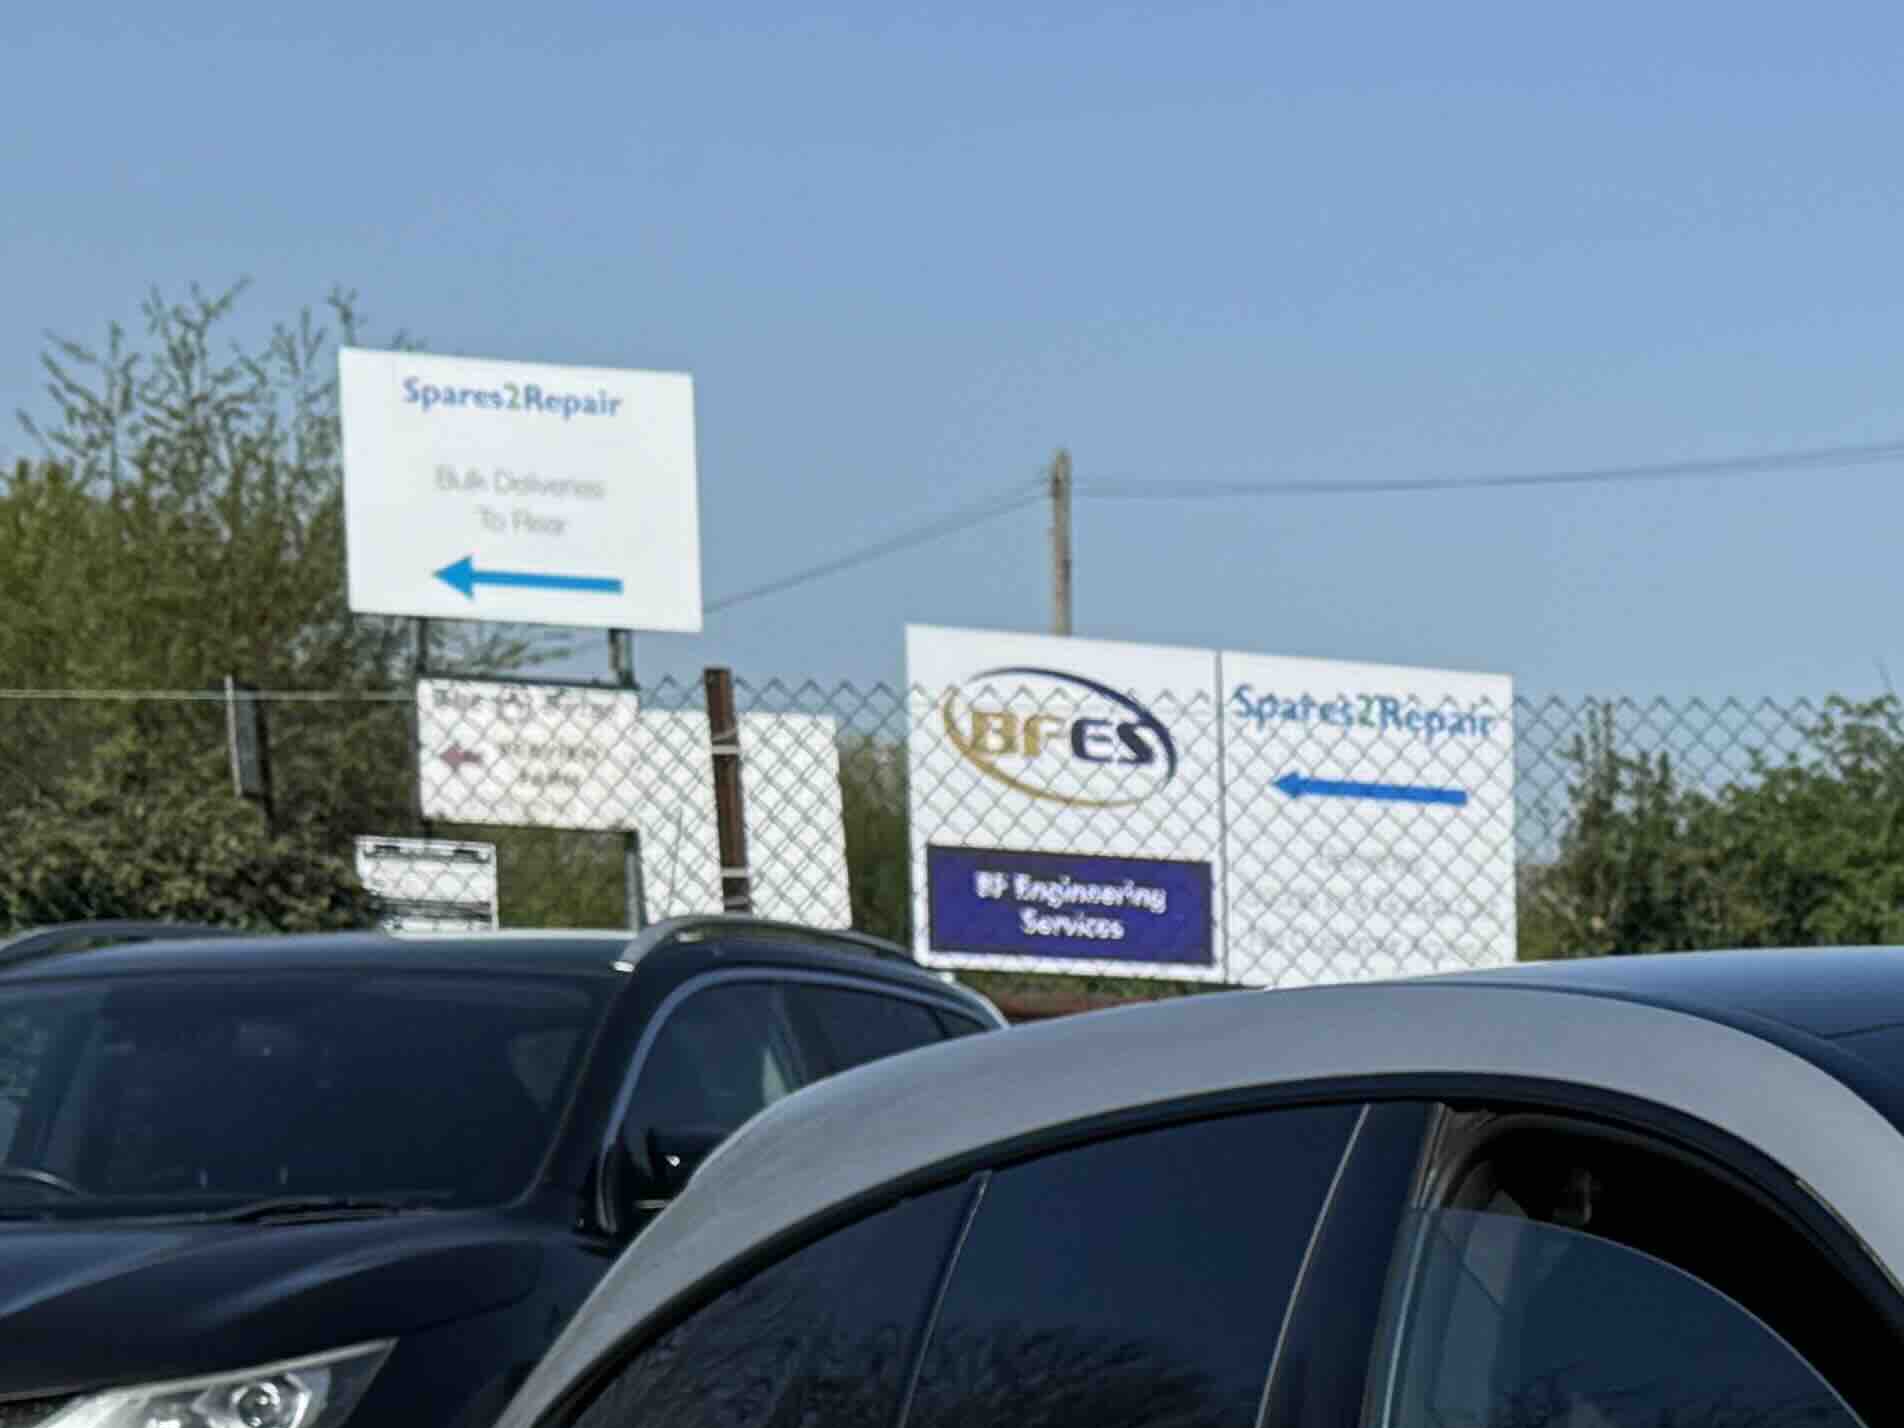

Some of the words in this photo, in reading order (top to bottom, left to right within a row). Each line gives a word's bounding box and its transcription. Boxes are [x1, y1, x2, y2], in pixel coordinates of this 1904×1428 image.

[403, 376, 622, 420] Spares2Repair
[1232, 683, 1494, 744] Spares2Repair
[973, 711, 1155, 764] BFES
[975, 870, 1009, 899] BF
[1013, 871, 1168, 915] Engineering
[1019, 906, 1126, 940] Services
